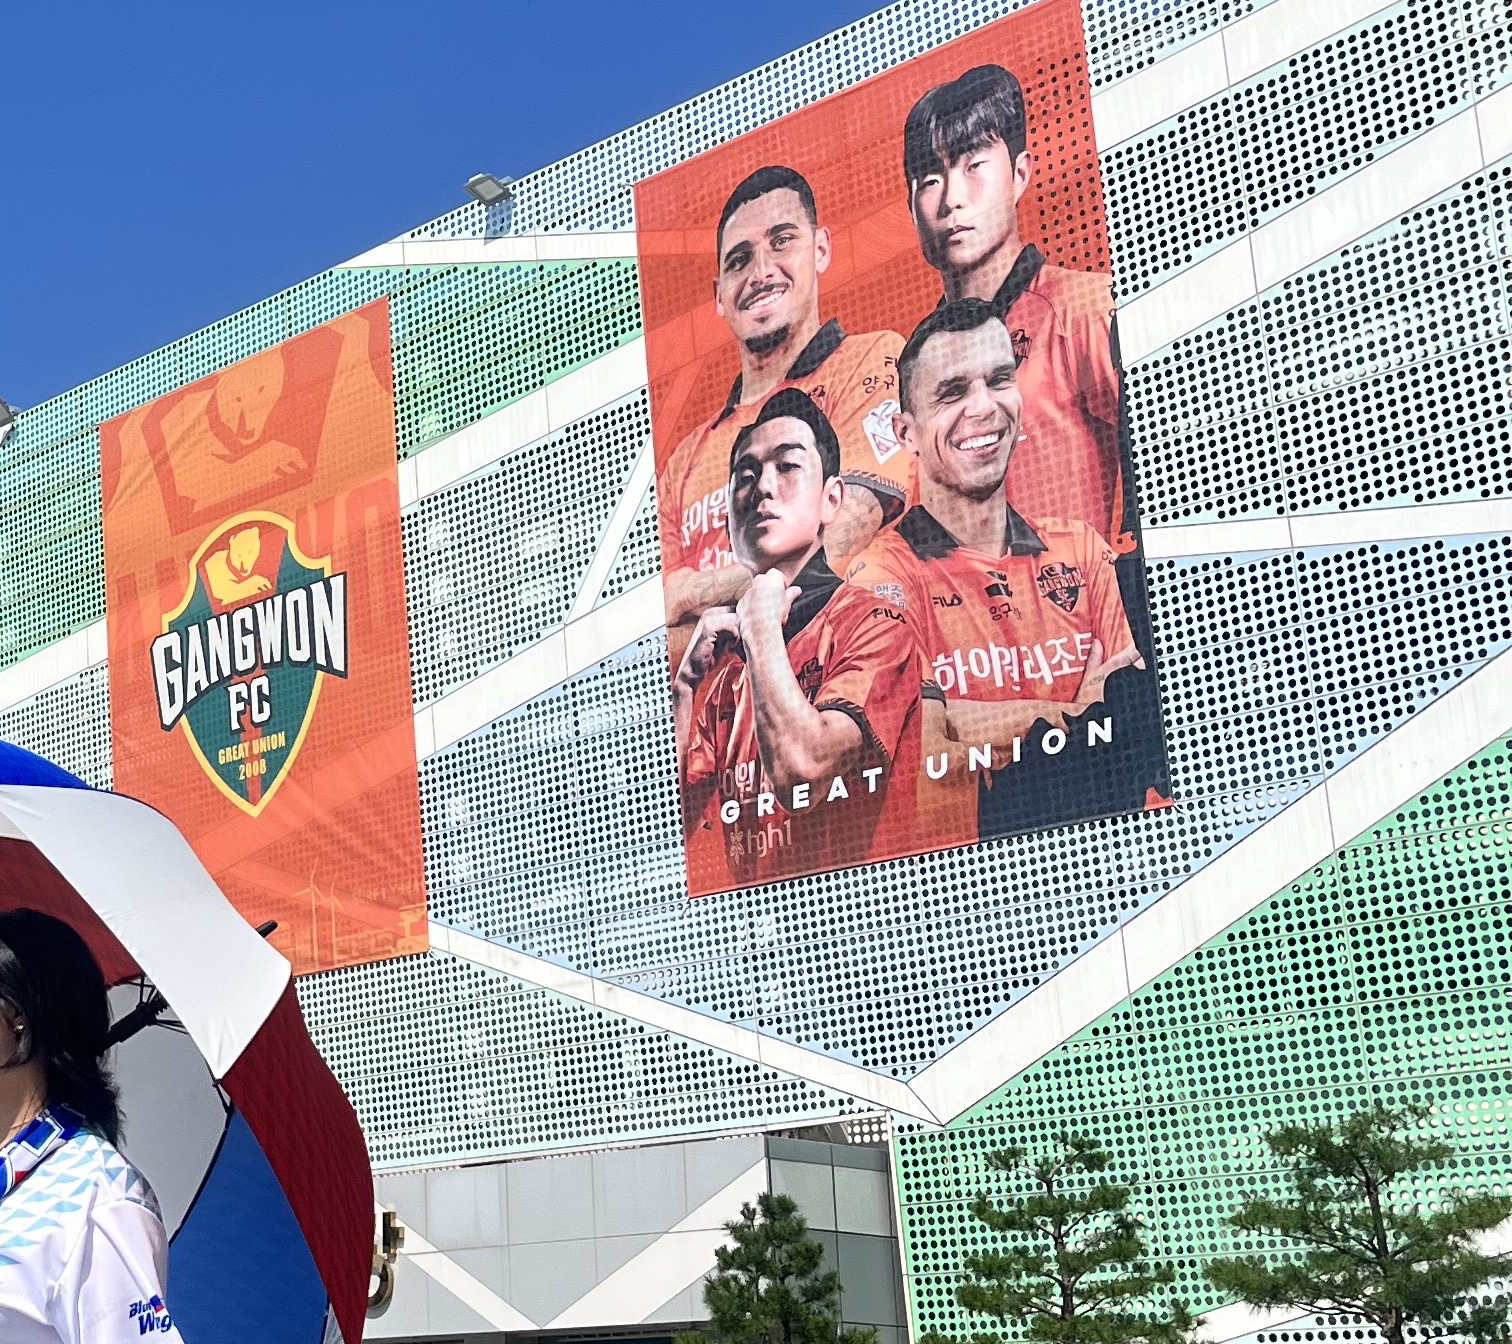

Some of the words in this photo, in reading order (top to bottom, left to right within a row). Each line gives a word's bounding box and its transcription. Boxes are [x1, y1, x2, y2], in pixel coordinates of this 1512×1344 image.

[872, 607, 907, 625] FILA
[932, 593, 963, 607] FILA
[150, 573, 348, 731] GANGWON
[228, 674, 272, 735] FC
[218, 741, 250, 766] GREAT
[252, 730, 286, 755] UNION
[238, 757, 267, 781] 2008
[720, 767, 883, 825] GREAT
[926, 716, 1113, 780] UNION
